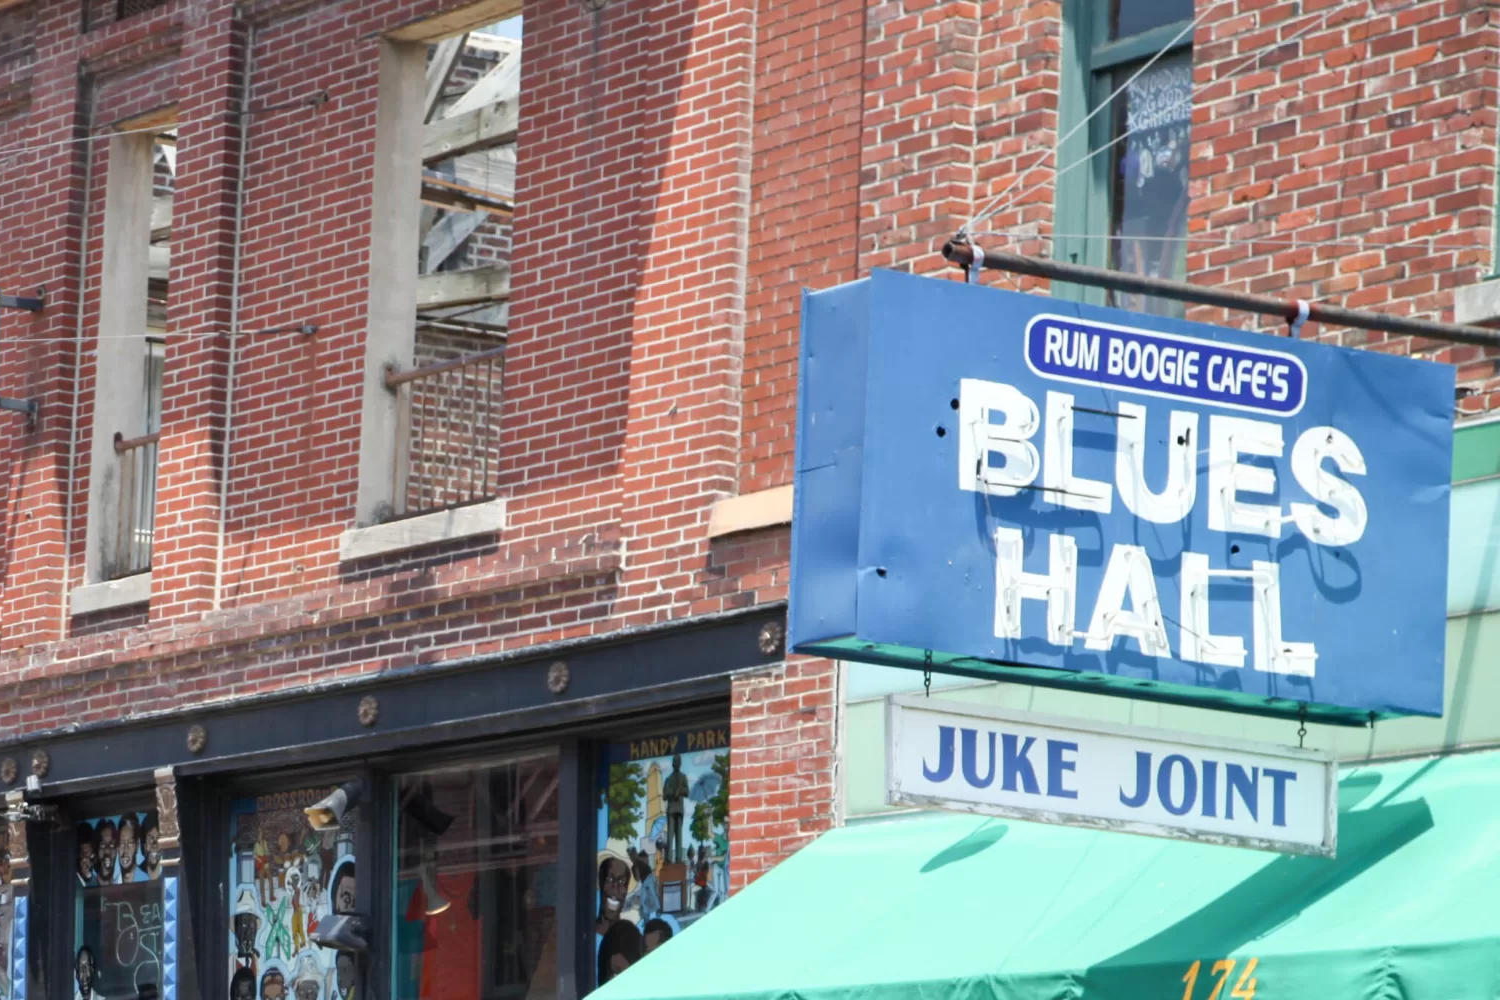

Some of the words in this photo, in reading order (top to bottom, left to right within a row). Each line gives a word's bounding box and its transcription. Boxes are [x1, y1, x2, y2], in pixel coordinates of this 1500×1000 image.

[1043, 325, 1100, 371] RUM
[1106, 337, 1199, 389] BOOGIE
[1206, 354, 1289, 402] CAFE'S
[959, 378, 1368, 547] BLUES
[994, 528, 1318, 678] HALL
[629, 736, 679, 760] HANDY
[687, 730, 727, 750] PARK
[922, 725, 1079, 801] JUKE
[1119, 751, 1297, 829] JOINT
